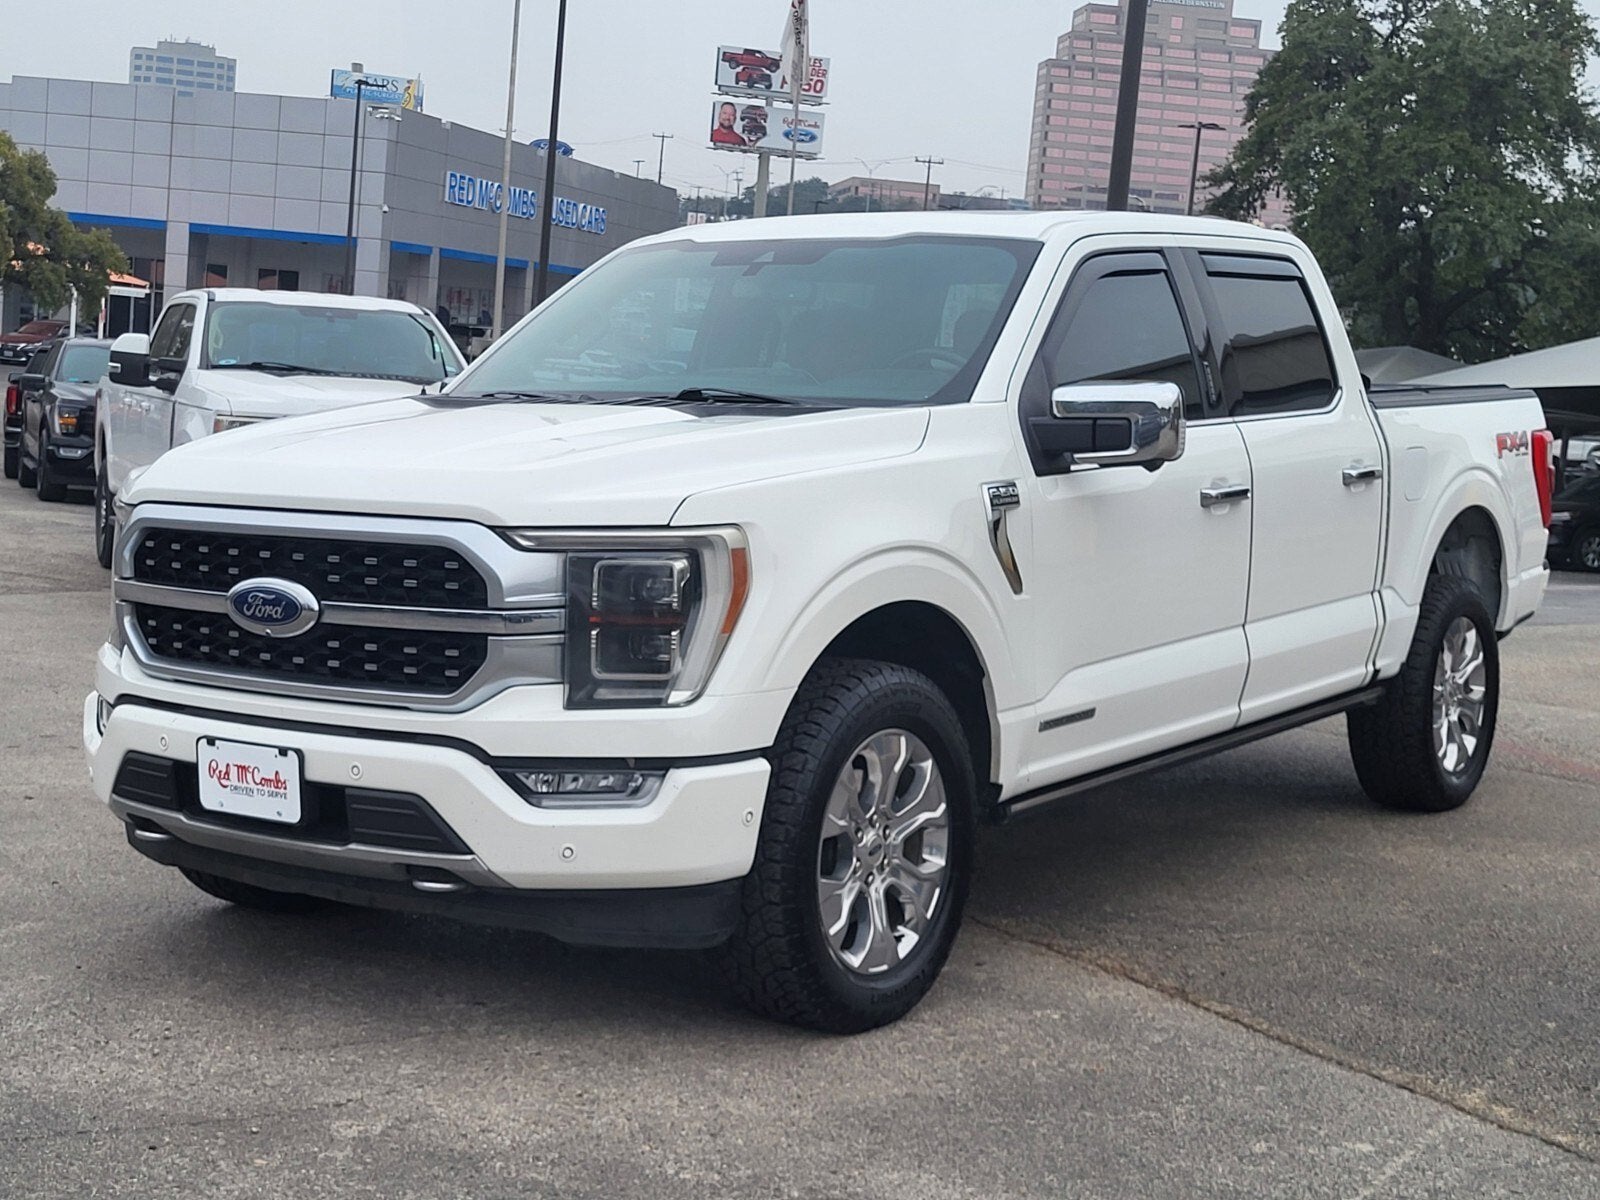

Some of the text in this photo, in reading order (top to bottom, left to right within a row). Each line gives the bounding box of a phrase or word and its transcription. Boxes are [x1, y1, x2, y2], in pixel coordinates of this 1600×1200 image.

[446, 171, 475, 207] RED
[551, 197, 578, 228] USED
[579, 204, 607, 234] CARS
[1496, 430, 1529, 459] FX4
[243, 592, 285, 619] Ford
[208, 758, 231, 789] Red
[229, 784, 288, 800] DRIVEN TO SERVE
